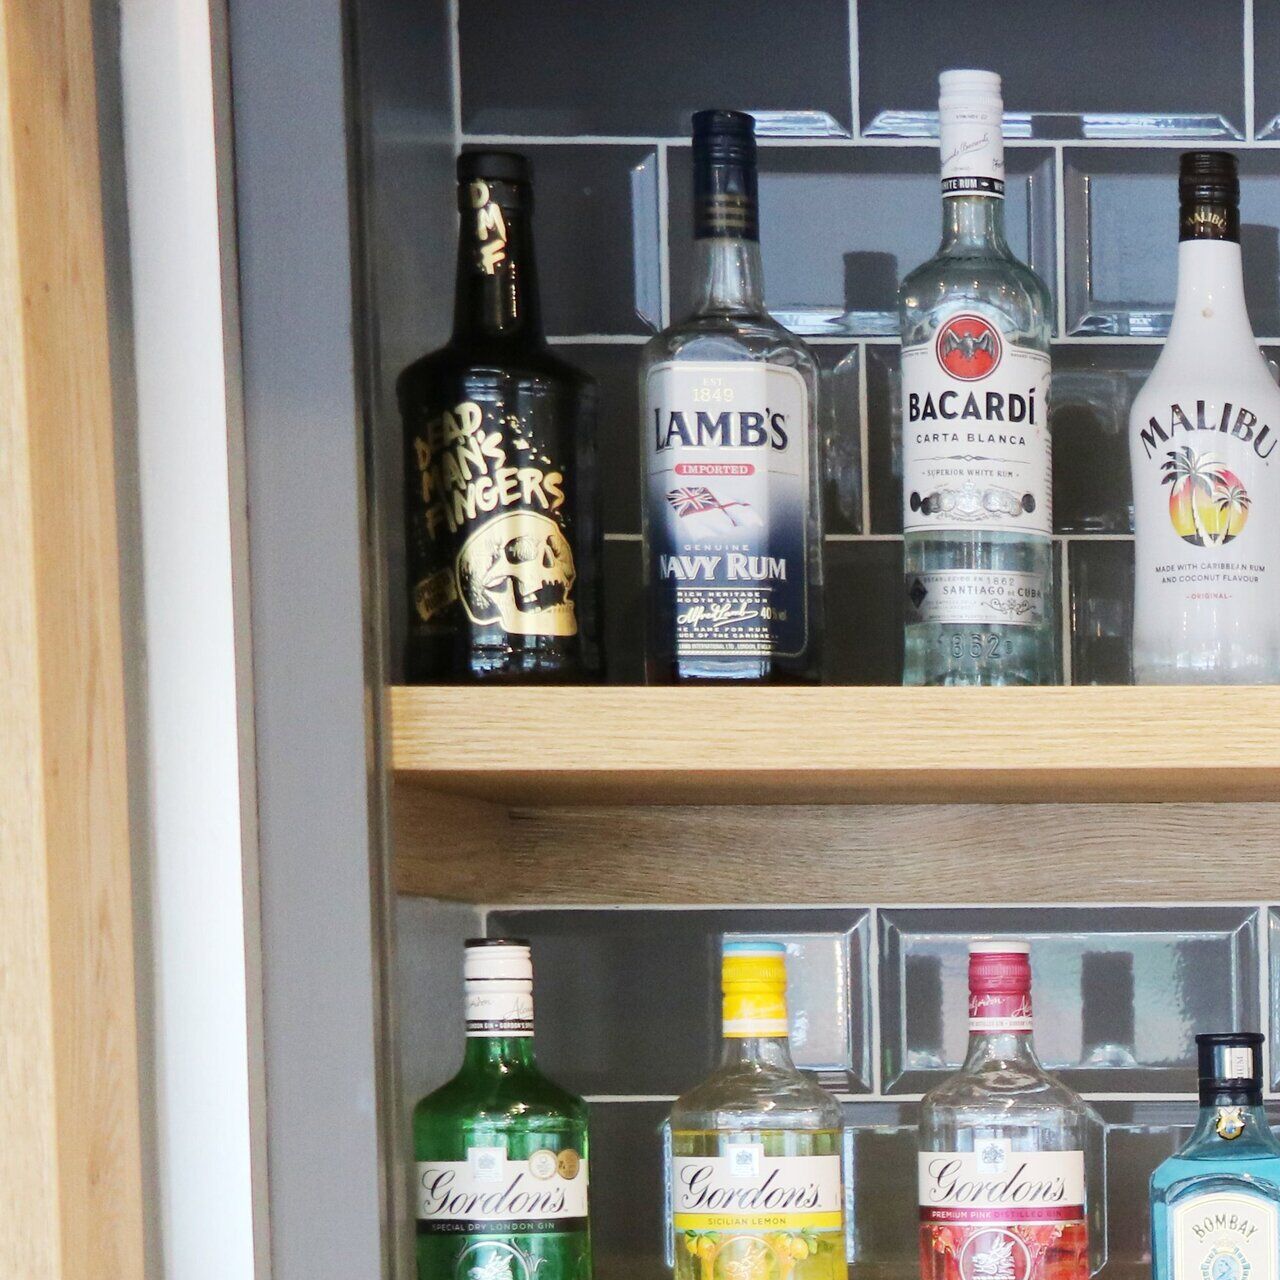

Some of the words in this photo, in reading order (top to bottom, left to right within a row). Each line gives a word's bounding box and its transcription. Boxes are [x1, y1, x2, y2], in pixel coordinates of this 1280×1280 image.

[692, 387, 735, 402] 1849
[909, 387, 1036, 425] BACARDÍ
[654, 407, 788, 451] LAMB'S
[1139, 400, 1278, 460] MALIBU
[916, 432, 959, 444] CARTA
[967, 432, 1026, 446] BLANCA
[681, 464, 749, 475] IMPORTED
[926, 469, 964, 478] SUPERIOR
[967, 468, 994, 477] WHITE
[996, 470, 1014, 478] RUM
[660, 553, 722, 581] NAVY
[727, 552, 787, 581] RUM
[1155, 565, 1175, 574] MADE
[1177, 563, 1198, 571] WITH
[1200, 562, 1248, 572] CARIBBEAN
[1249, 564, 1266, 573] RUM
[1161, 576, 1177, 584] AND
[1179, 574, 1220, 583] COCONUT
[1222, 574, 1259, 584] FLAVOUR
[943, 585, 1005, 596] SANTIAGO
[1017, 587, 1042, 599] CUBA
[679, 1163, 821, 1211] Gordon's
[927, 1157, 1067, 1205] Gordon's
[421, 1168, 569, 1218] Gordon's
[707, 1217, 748, 1226] SICILIAN
[751, 1217, 787, 1226] LEMON
[931, 1210, 969, 1220] PREMIUM
[970, 1210, 992, 1219] PINK
[993, 1210, 1044, 1219] DISTILLED
[431, 1222, 465, 1232] SPECIAL
[467, 1222, 487, 1231] DRY
[489, 1222, 536, 1231] LONDON
[537, 1221, 556, 1230] GIN
[1191, 1212, 1259, 1241] BOMBAY
